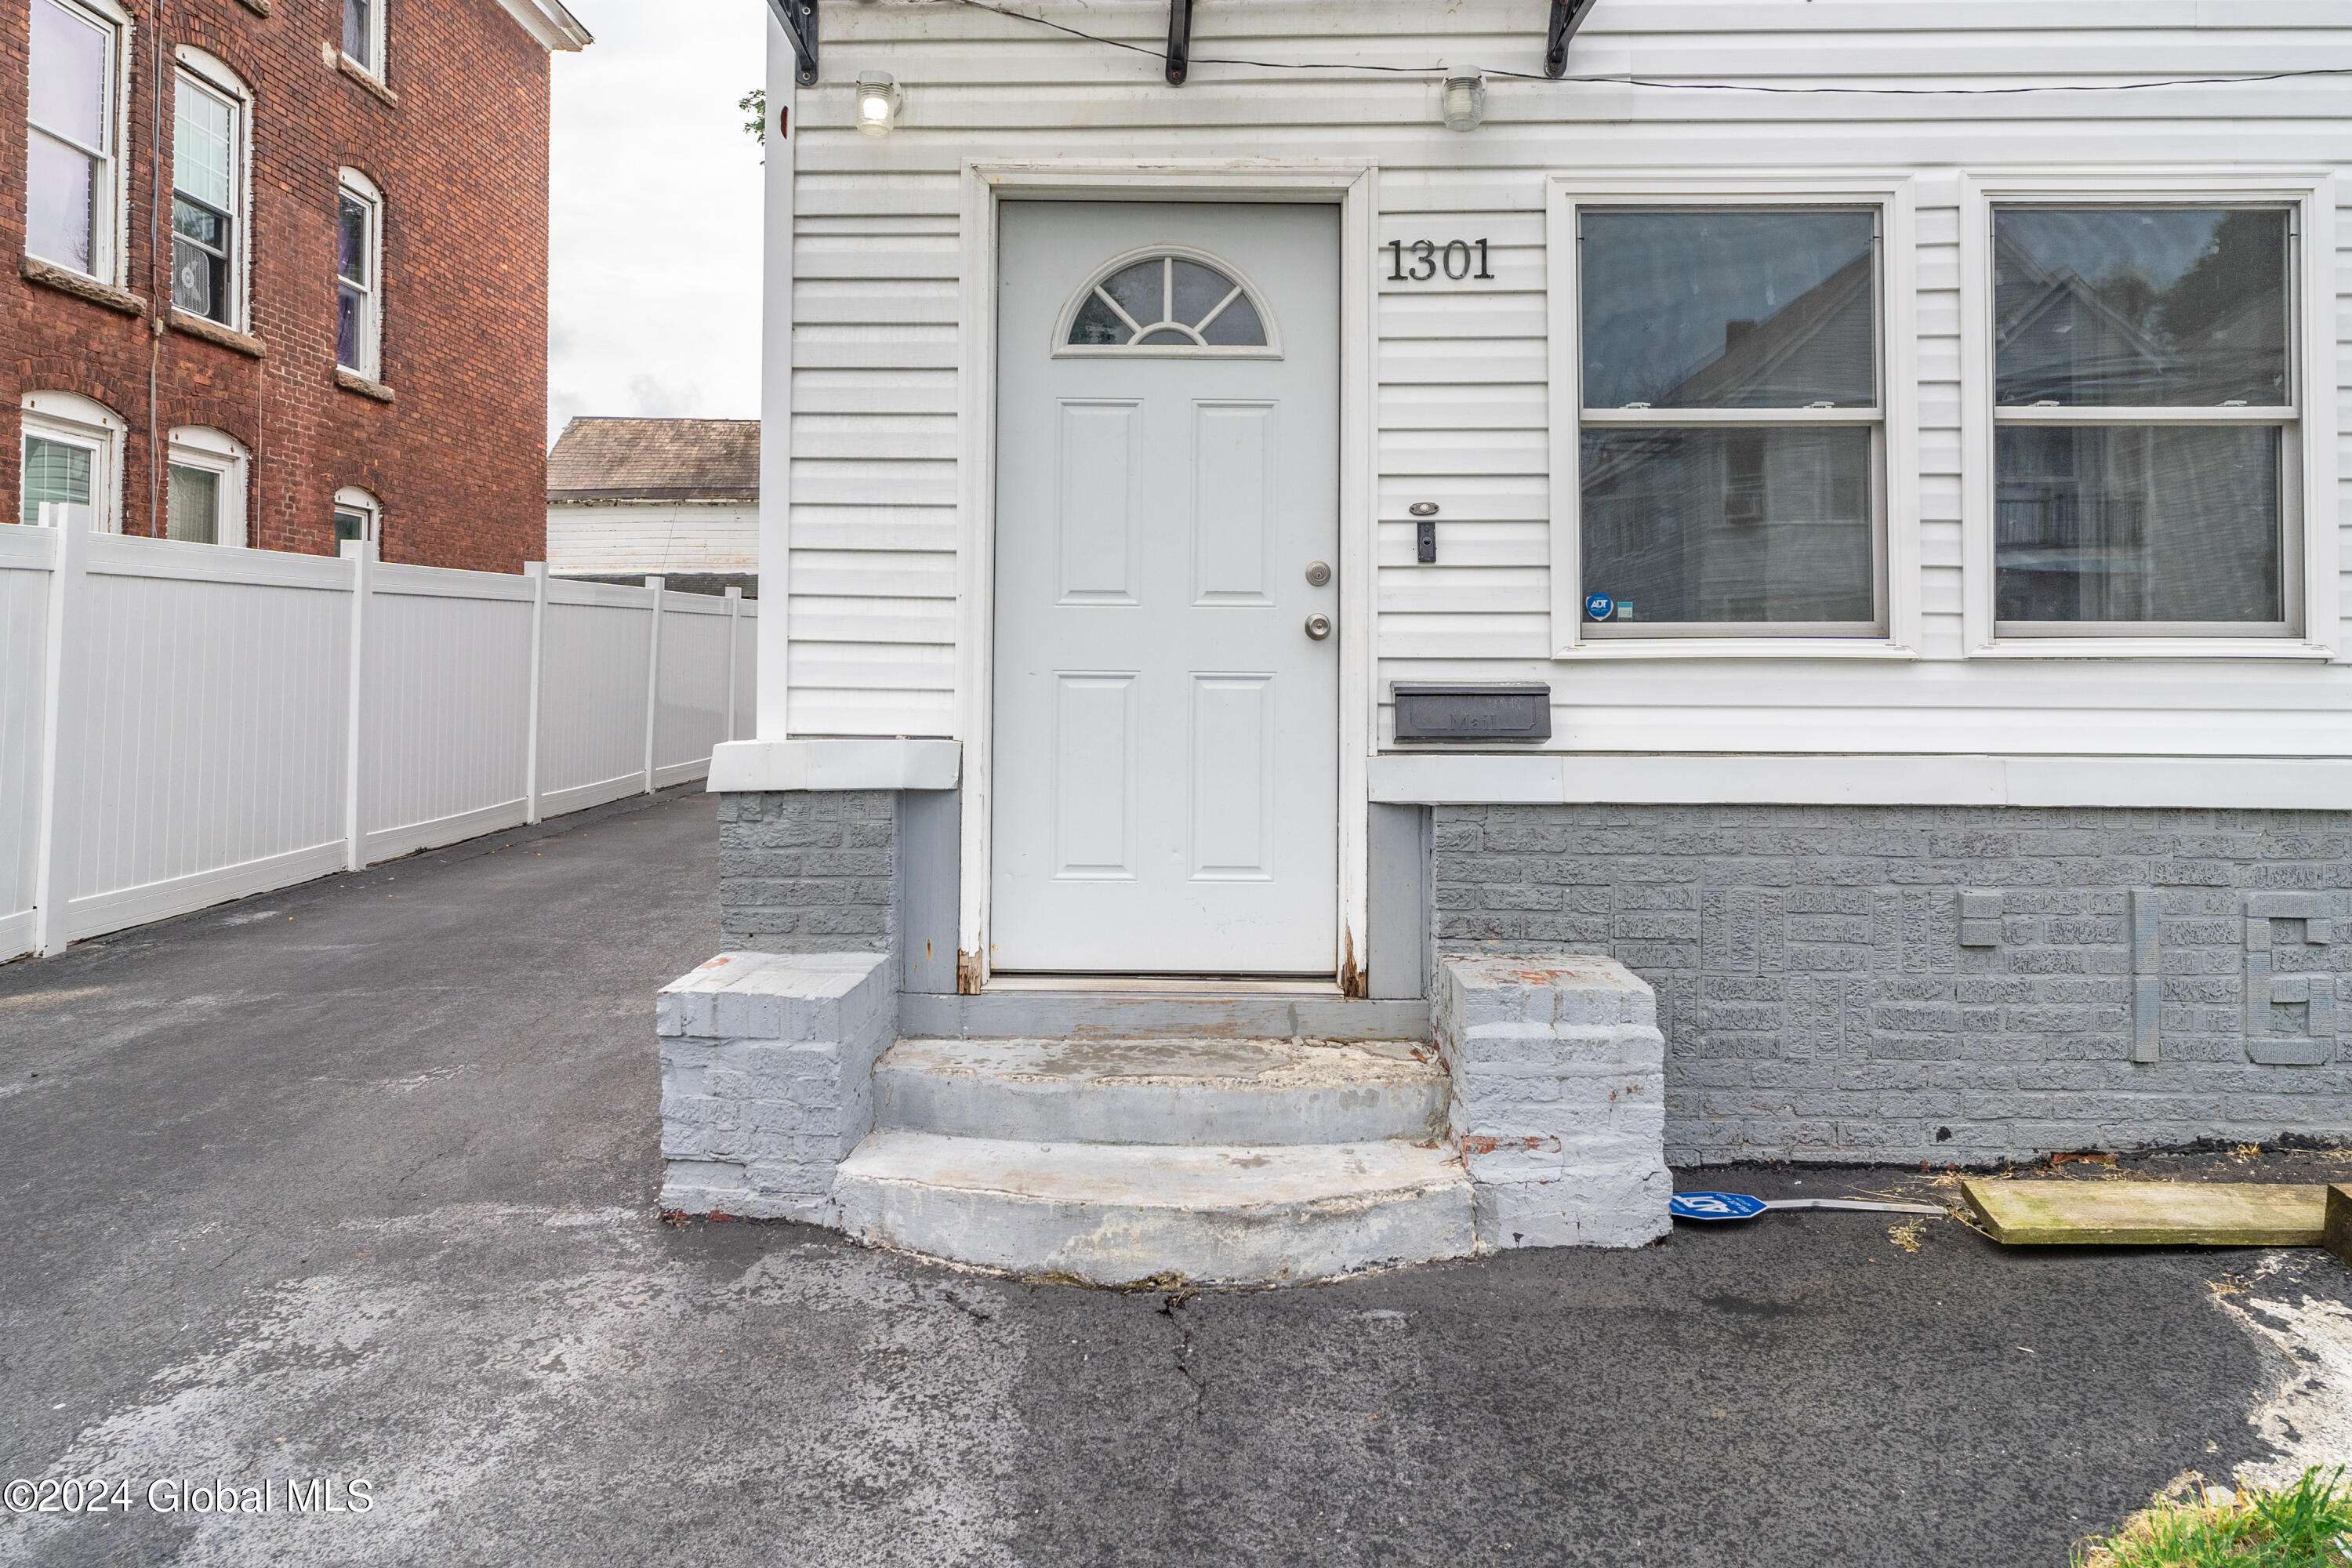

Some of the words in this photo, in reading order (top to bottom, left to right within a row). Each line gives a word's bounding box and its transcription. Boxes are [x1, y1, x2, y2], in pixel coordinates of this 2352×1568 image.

[1388, 238, 1494, 280] 1301
[1591, 599, 1608, 608] ADT
[1449, 713, 1494, 729] Mail
[1671, 1195, 1740, 1214] ADT
